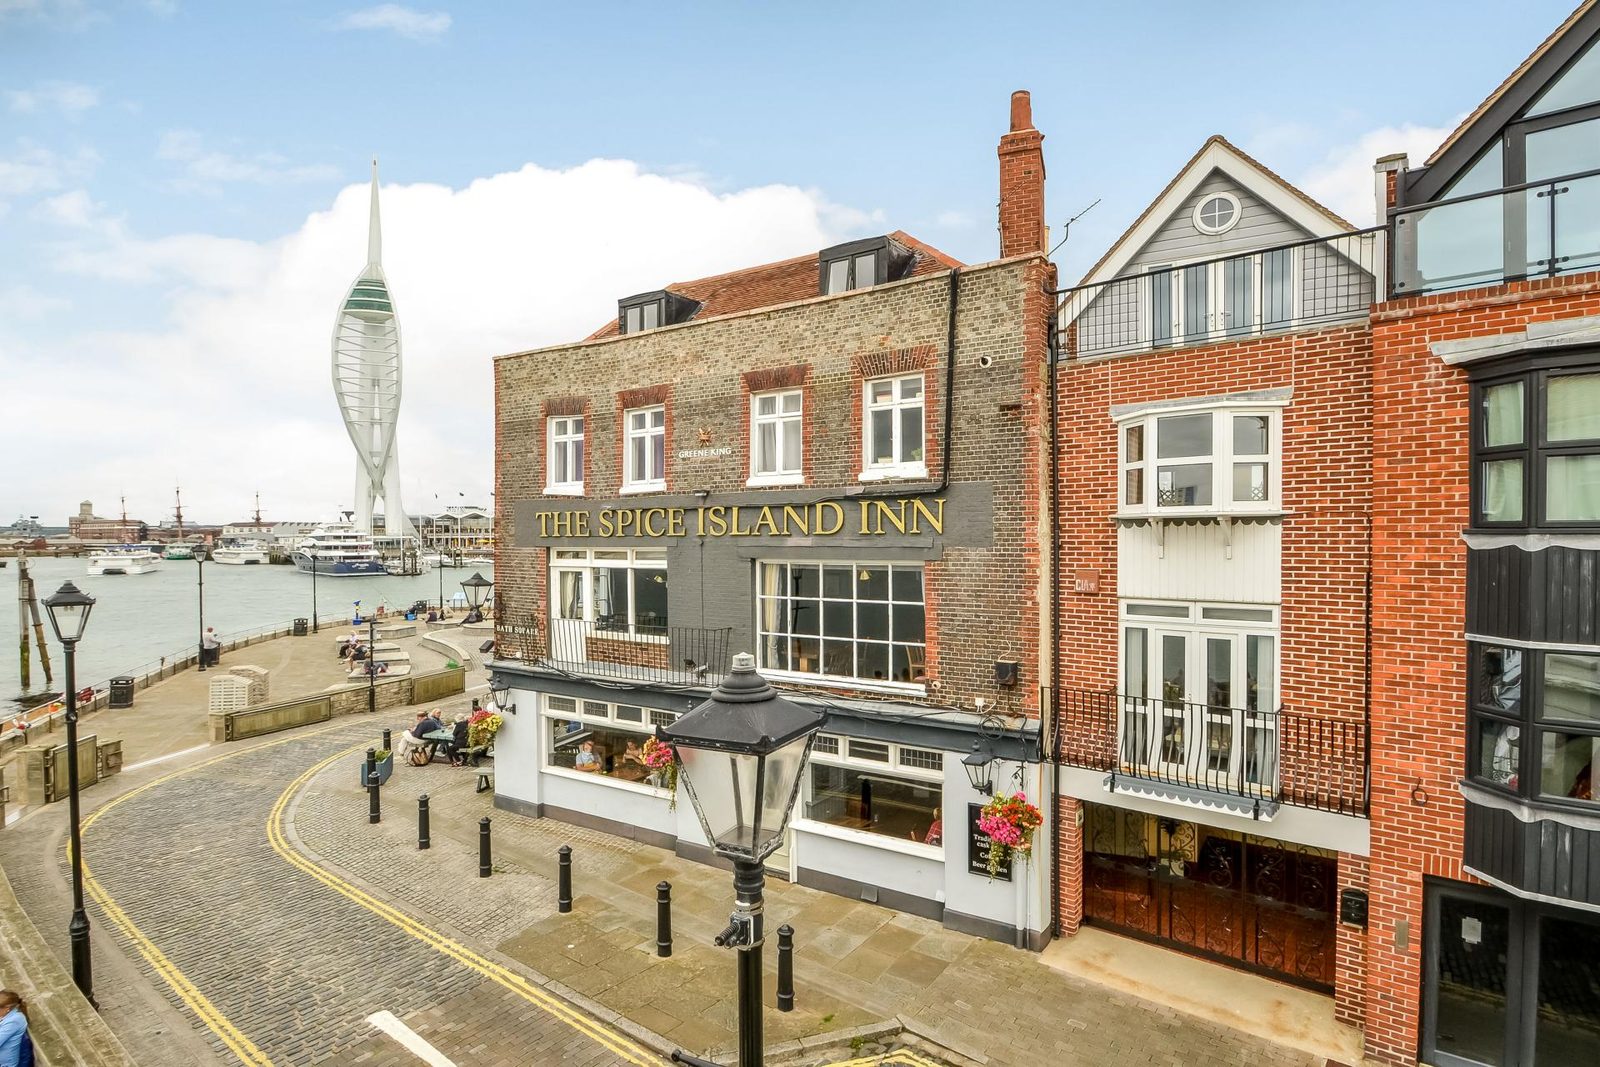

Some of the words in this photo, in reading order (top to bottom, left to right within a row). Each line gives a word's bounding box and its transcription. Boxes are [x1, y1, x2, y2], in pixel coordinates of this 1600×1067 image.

[678, 449, 709, 458] GREENE
[711, 447, 732, 456] KING
[535, 510, 592, 538] THE
[598, 507, 687, 538] SPICE
[696, 500, 845, 537] ISLAND
[858, 498, 947, 535] INN
[496, 624, 513, 633] BATH
[514, 626, 539, 635] SQUARE
[972, 860, 986, 869] Beer
